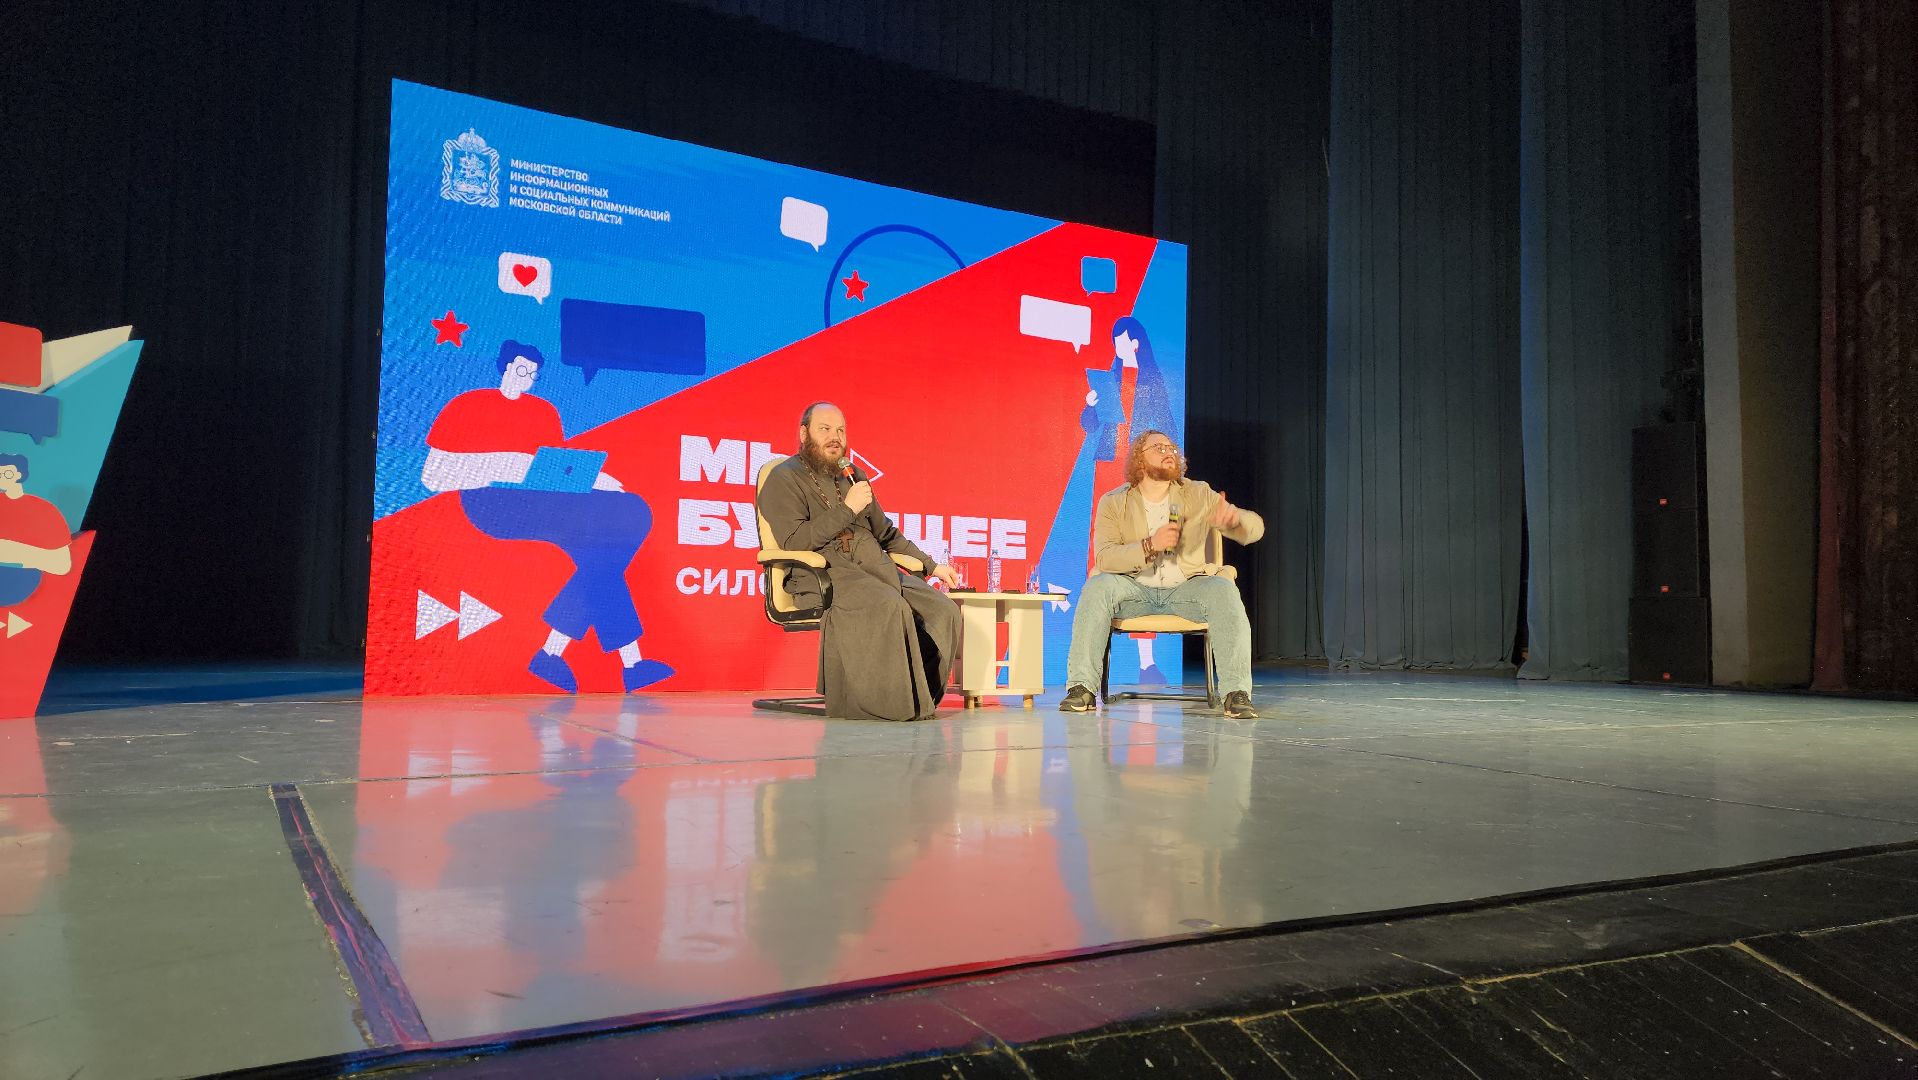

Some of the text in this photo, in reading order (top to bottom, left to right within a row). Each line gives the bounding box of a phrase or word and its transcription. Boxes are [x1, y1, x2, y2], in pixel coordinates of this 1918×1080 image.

[510, 158, 588, 182] МИНИСТЕРСТВО
[510, 171, 609, 198] ИНФОРМАЦИОННЫХ
[509, 184, 671, 222] И СОЦИАЛЬНЫХ КОММУНИКАЦИЙ
[509, 197, 623, 225] МОСКОВСКОЙ ОБЛАСТИ
